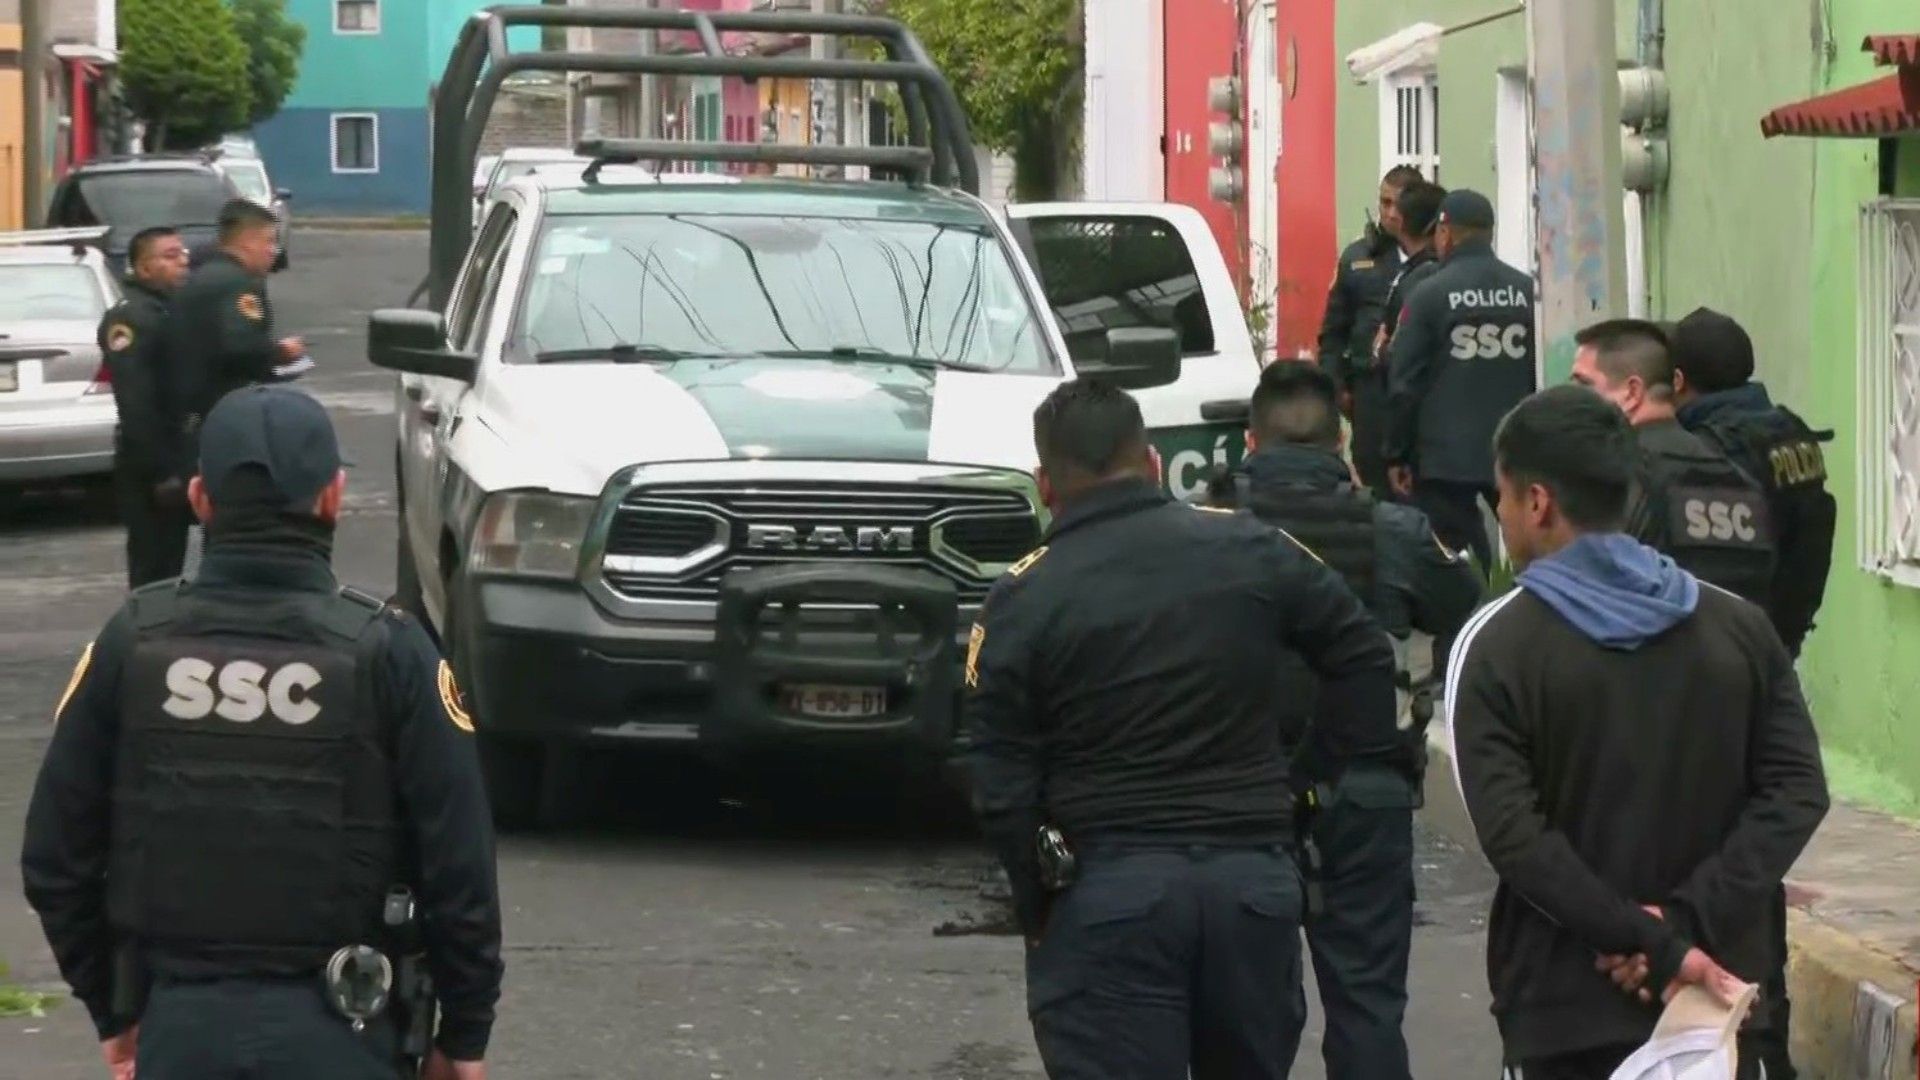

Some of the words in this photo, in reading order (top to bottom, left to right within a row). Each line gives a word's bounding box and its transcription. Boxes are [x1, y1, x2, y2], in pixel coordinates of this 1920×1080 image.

[1450, 323, 1528, 359] SSC
[748, 524, 914, 550] RAM
[1685, 499, 1755, 542] SSC
[162, 657, 323, 725] SSC
